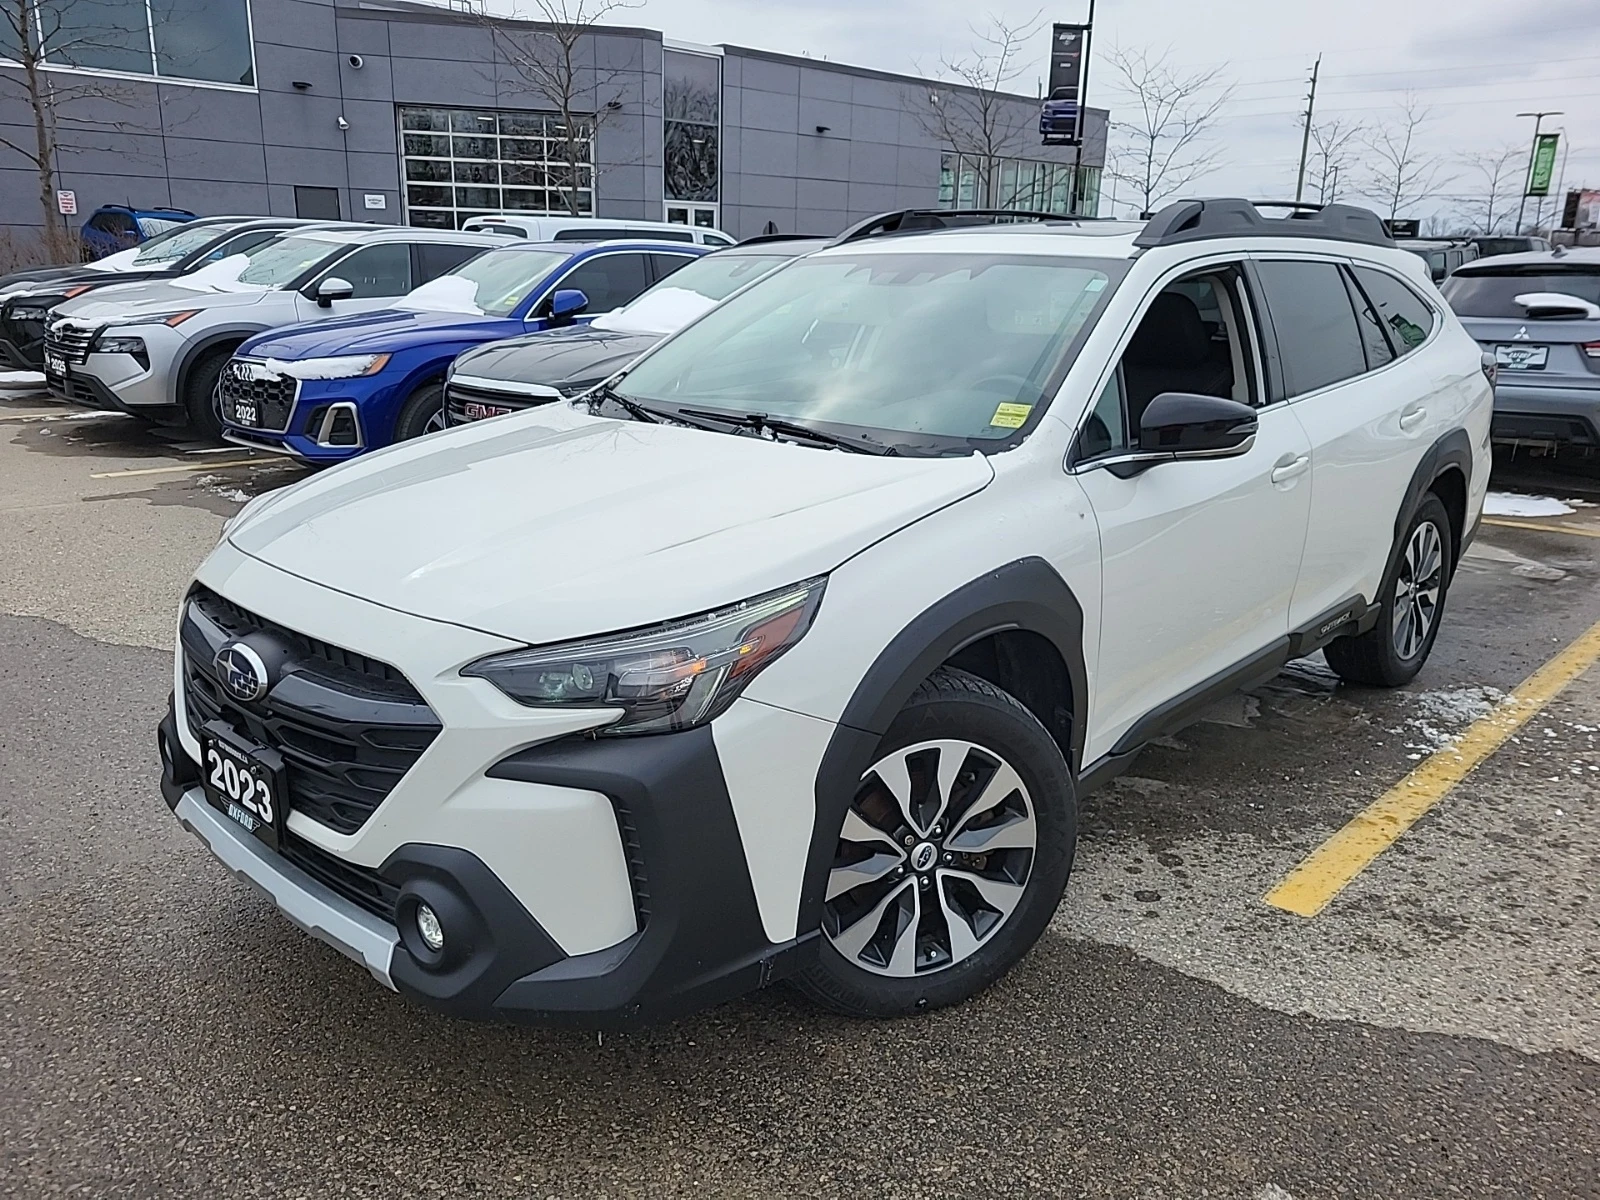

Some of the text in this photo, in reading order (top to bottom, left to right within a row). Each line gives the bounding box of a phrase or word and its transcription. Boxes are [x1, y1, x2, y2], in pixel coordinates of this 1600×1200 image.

[235, 404, 257, 421] 2022
[207, 748, 273, 823] 2023
[227, 803, 254, 830] OXFORD
